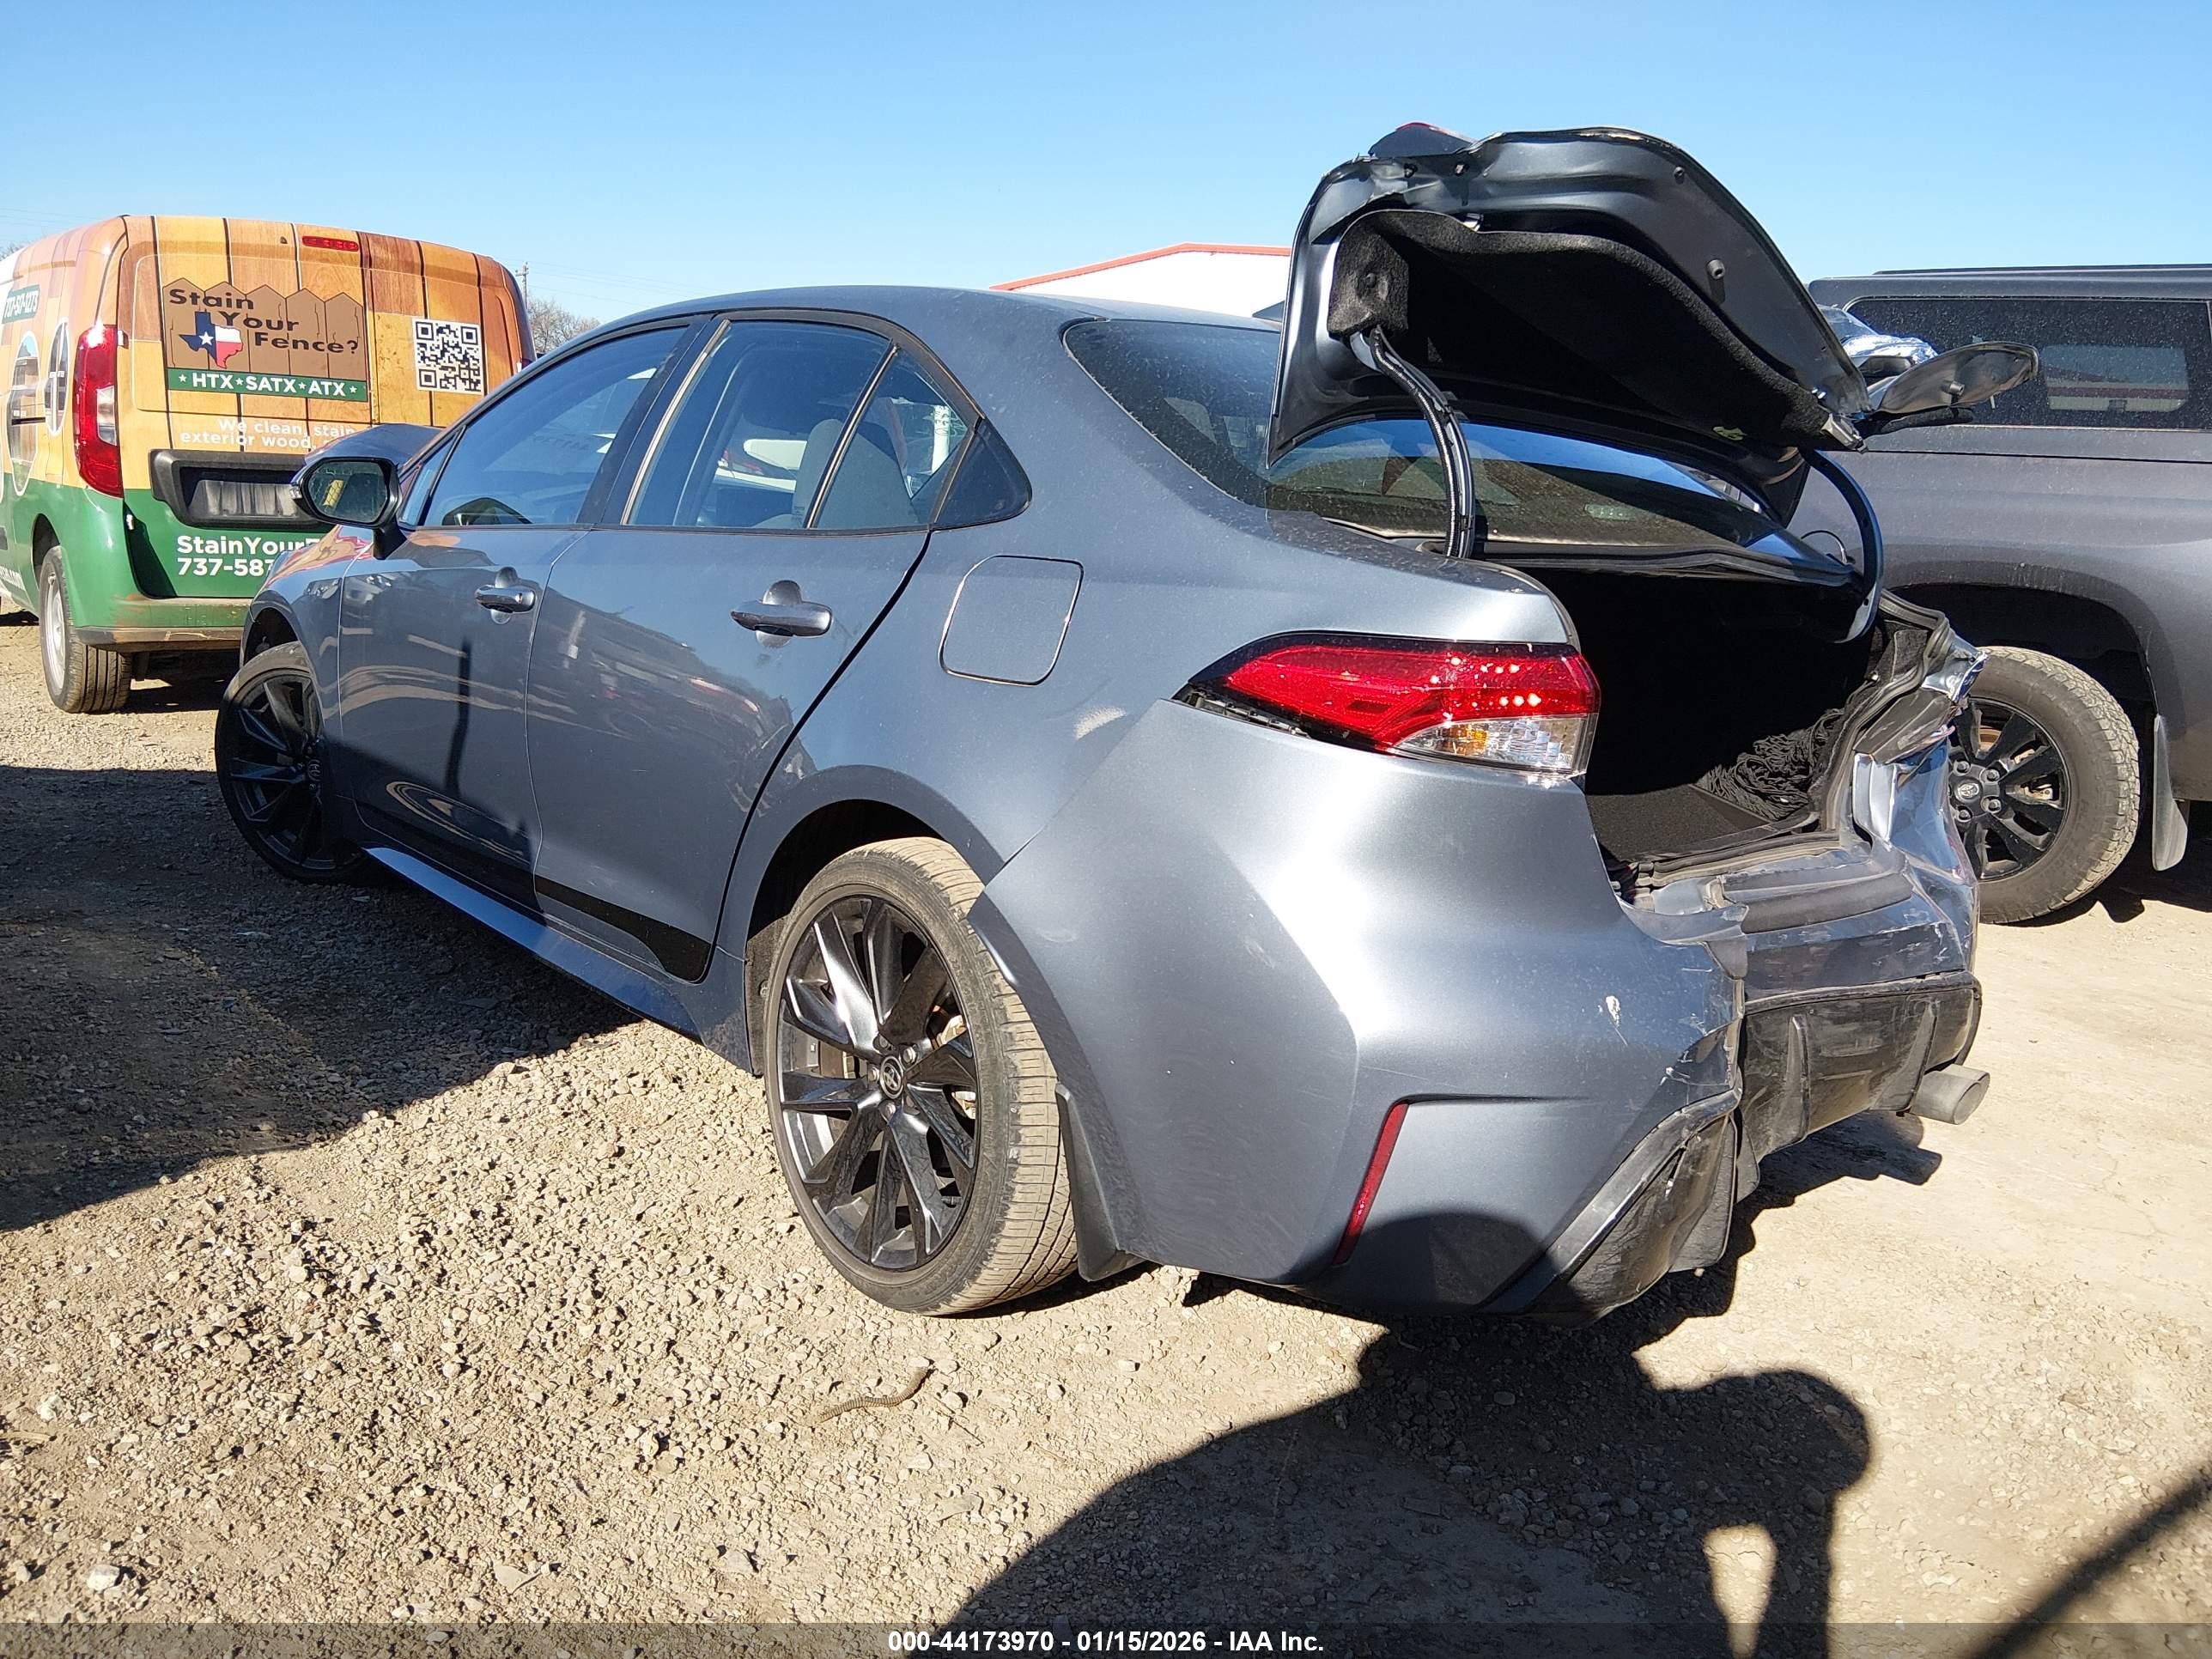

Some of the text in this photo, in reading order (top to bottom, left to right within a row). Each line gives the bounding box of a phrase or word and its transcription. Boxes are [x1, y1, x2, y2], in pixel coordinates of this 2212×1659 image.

[169, 289, 254, 310] Stain
[219, 311, 299, 331] Your
[254, 331, 360, 354] Fence?
[192, 373, 346, 397] HTX SATX ATX
[179, 429, 254, 446] exterior
[219, 418, 247, 431] We
[253, 421, 308, 437] clean,
